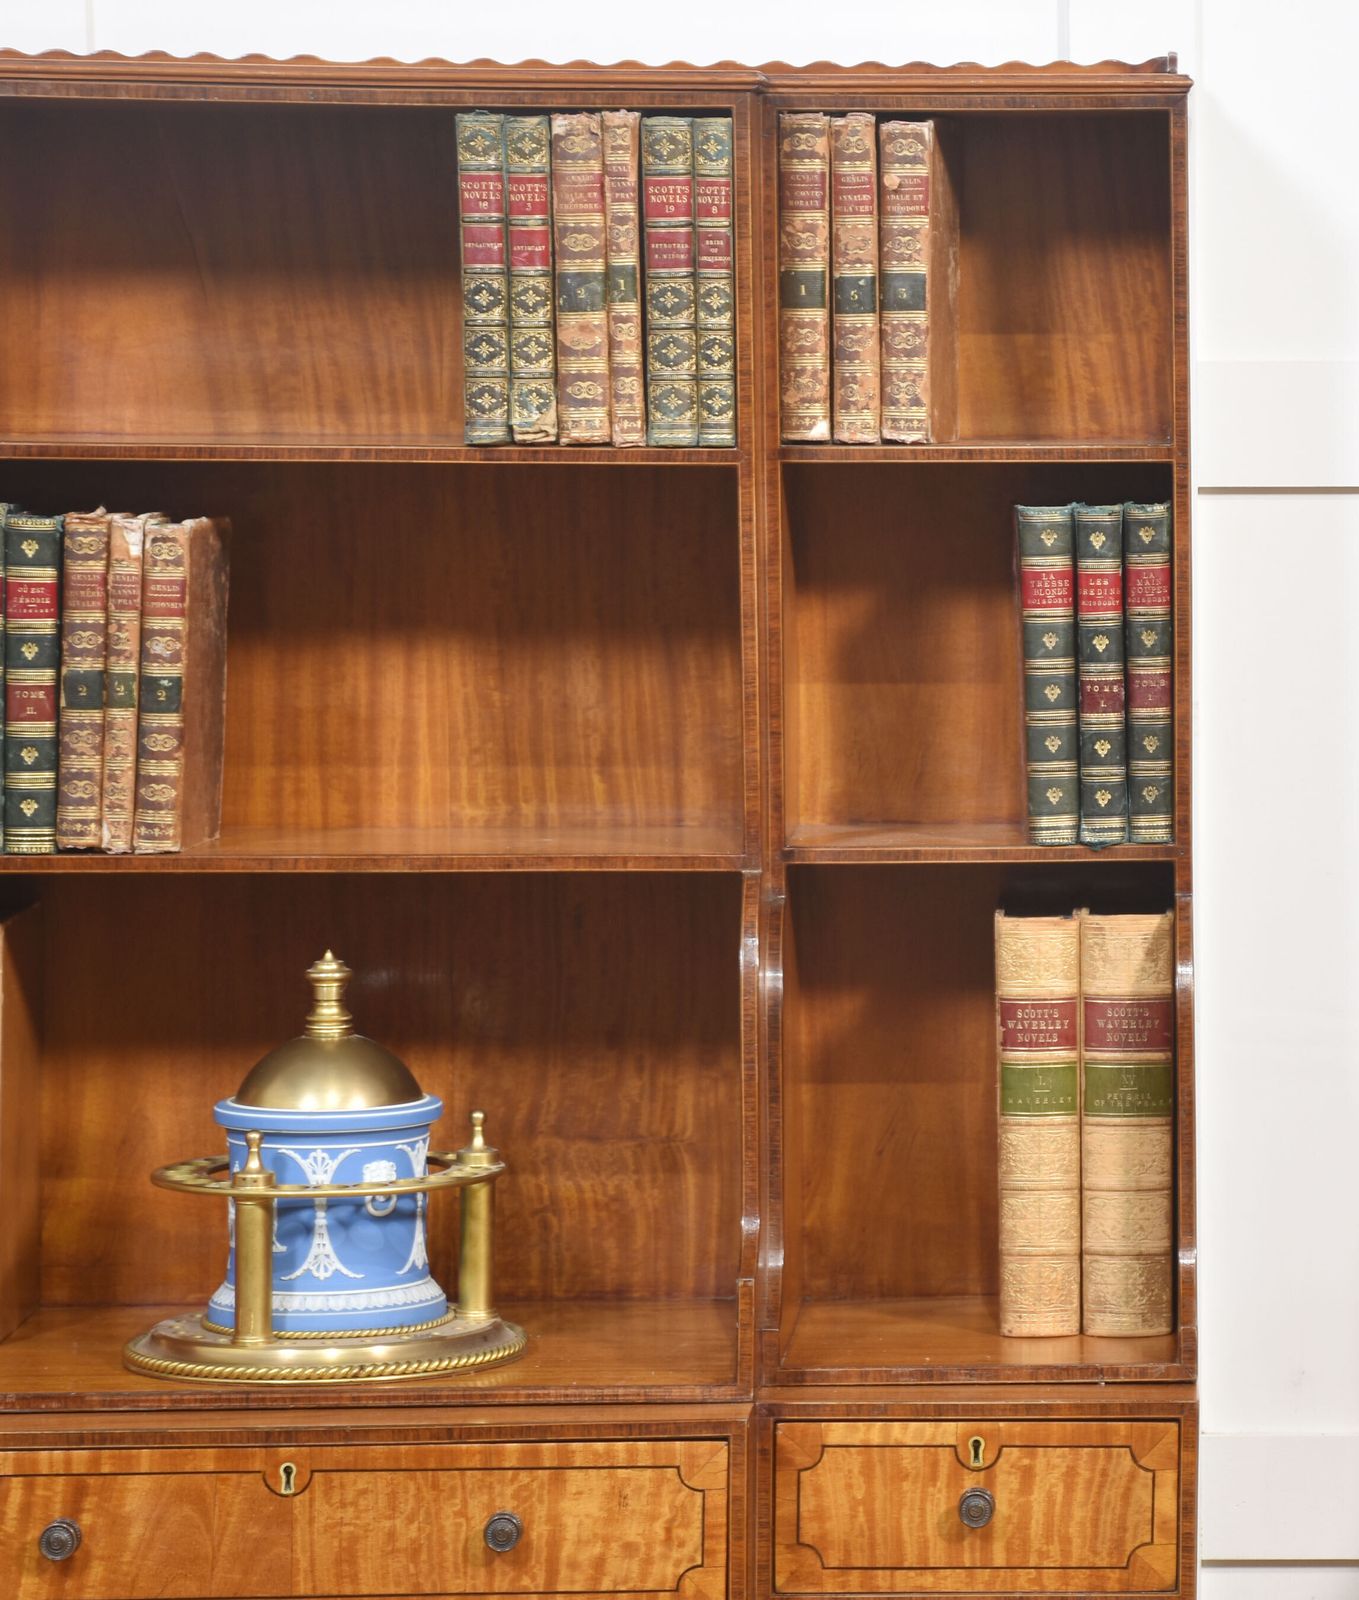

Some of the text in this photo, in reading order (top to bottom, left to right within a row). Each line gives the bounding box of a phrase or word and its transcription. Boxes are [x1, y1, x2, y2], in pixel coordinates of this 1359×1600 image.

[461, 181, 503, 190] SCOTT'S
[648, 185, 690, 194] SCOTT'S
[464, 191, 501, 200] NOVELS
[510, 193, 547, 202] NOVELS
[650, 194, 688, 204] NOVELS
[525, 202, 533, 211] 3
[665, 205, 675, 214] 19
[711, 205, 719, 214] 8
[618, 279, 626, 290] 1
[576, 287, 586, 298] 2
[799, 284, 807, 296] 1
[1042, 573, 1056, 581] LA
[1143, 572, 1156, 580] LA
[1029, 579, 1070, 588] TRESSE
[1089, 578, 1109, 586] LES
[1033, 587, 1068, 596] BLONDE
[15, 690, 46, 698] TOME
[77, 684, 87, 696] 2
[156, 689, 166, 700] 2
[1016, 1008, 1060, 1018] SCOTT'S
[1106, 1007, 1150, 1017] SCOTT'S
[1007, 1019, 1070, 1029] WAVERLEY
[1097, 1018, 1160, 1029] WAVERLEY
[1017, 1032, 1059, 1043] NOVELS
[1106, 1031, 1148, 1042] NOVELS
